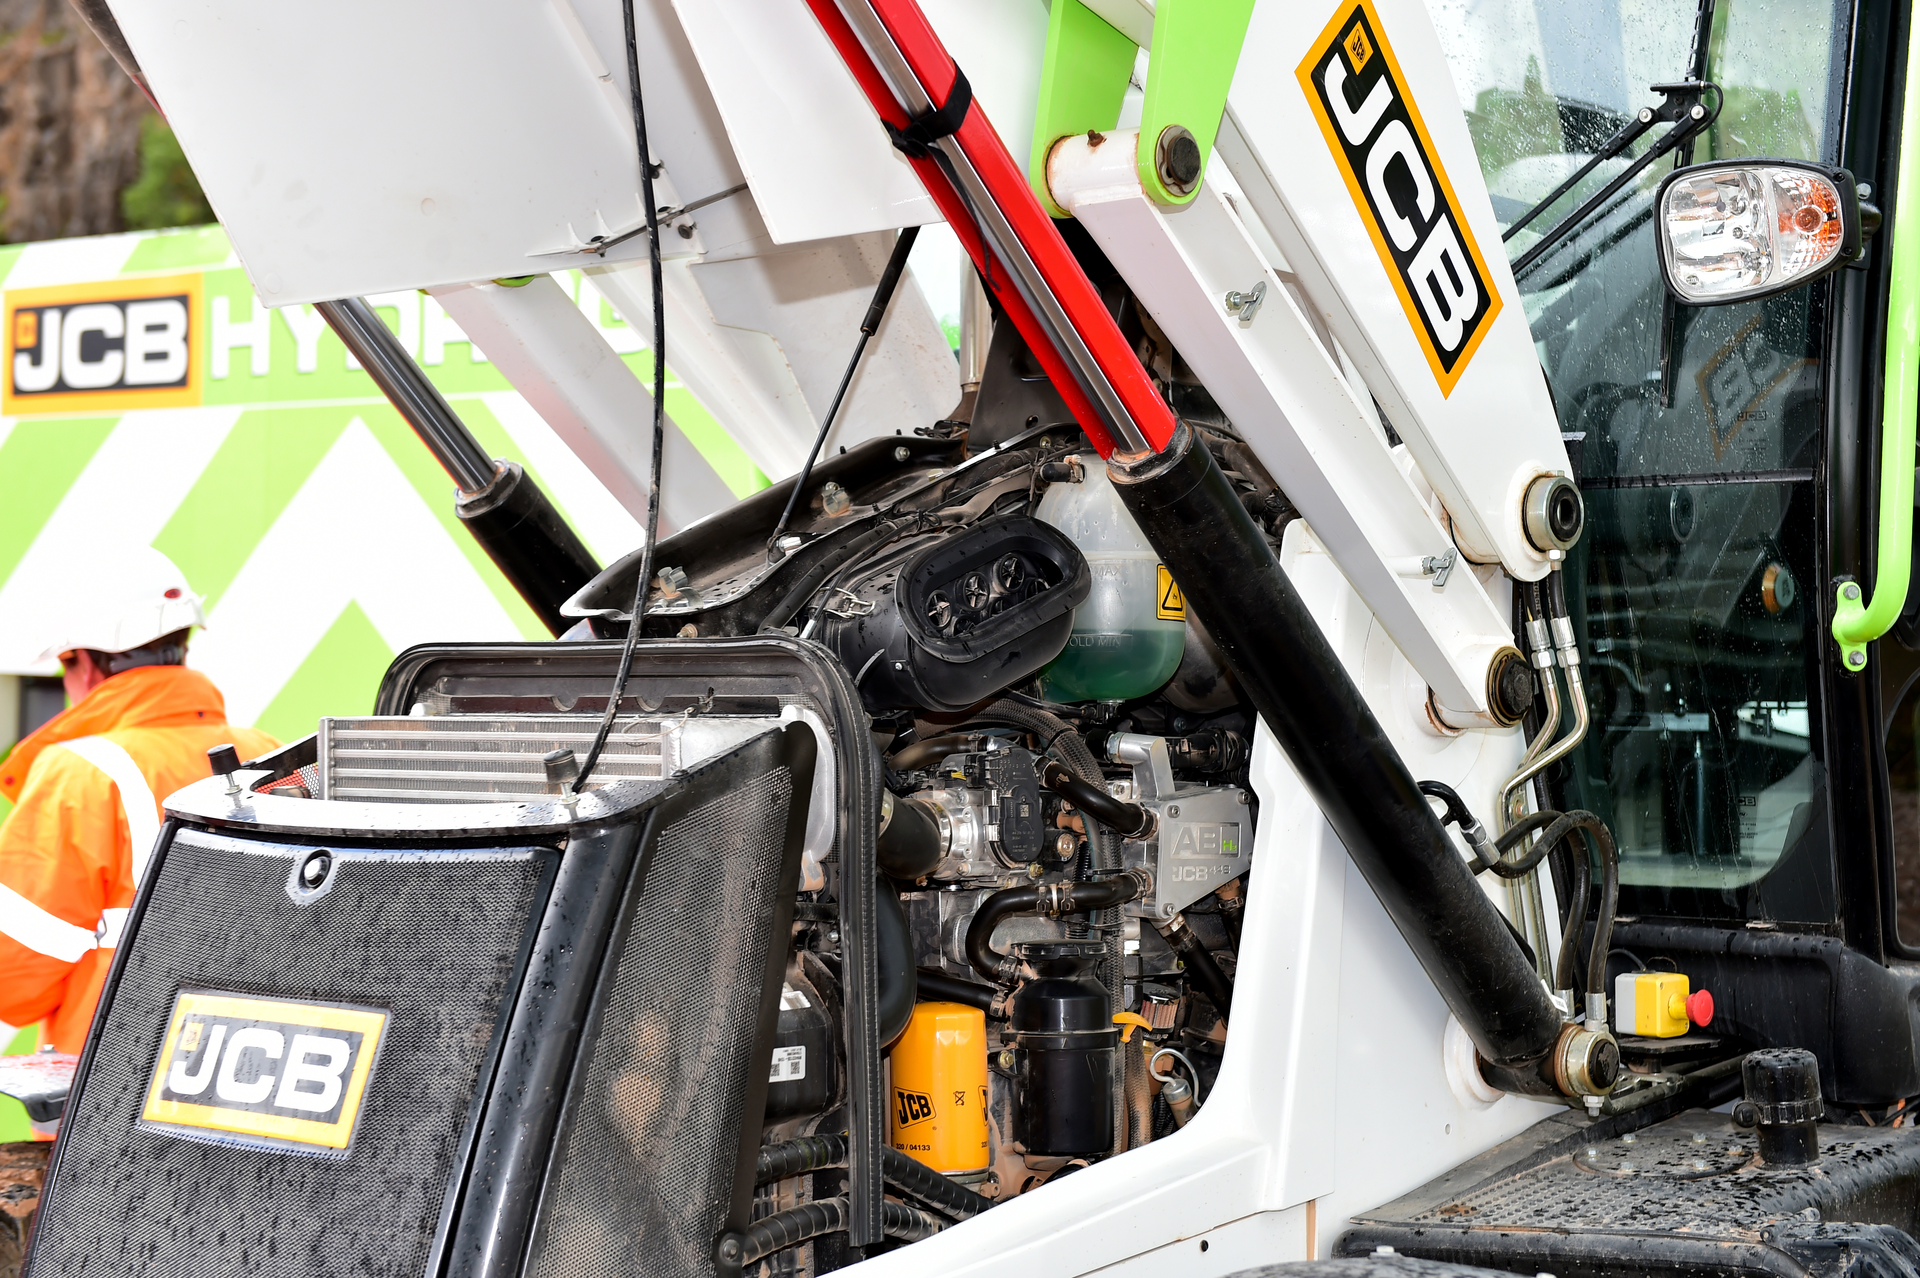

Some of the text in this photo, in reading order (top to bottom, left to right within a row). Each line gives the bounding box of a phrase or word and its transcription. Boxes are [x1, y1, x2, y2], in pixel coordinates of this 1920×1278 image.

[1353, 35, 1364, 60] JCB
[1324, 52, 1479, 352] JCB
[14, 299, 188, 392] JCB
[1068, 636, 1094, 647] OLD
[1172, 866, 1208, 882] JCB
[168, 1024, 351, 1113] JCB
[897, 1091, 932, 1125] JCB
